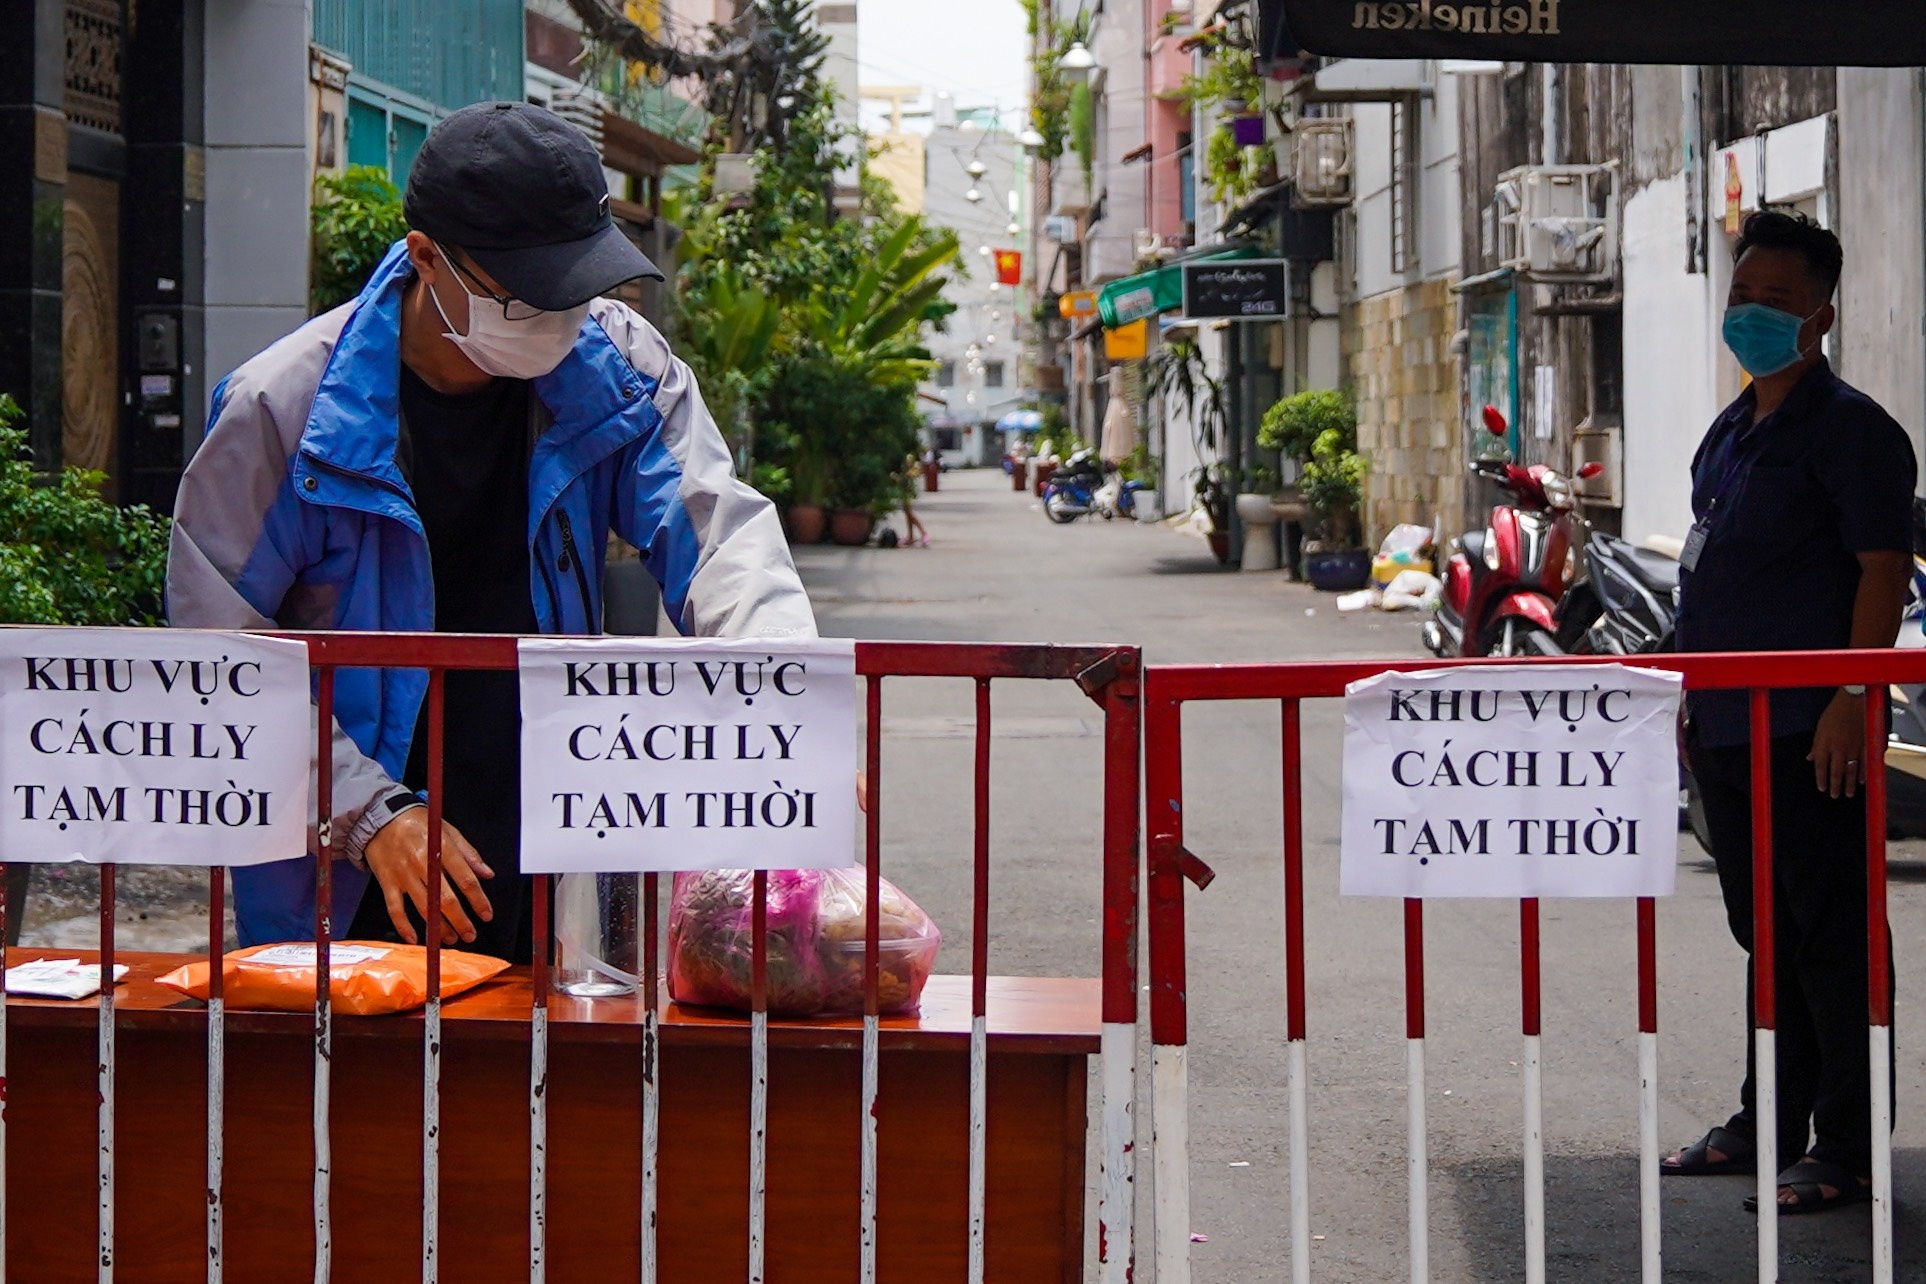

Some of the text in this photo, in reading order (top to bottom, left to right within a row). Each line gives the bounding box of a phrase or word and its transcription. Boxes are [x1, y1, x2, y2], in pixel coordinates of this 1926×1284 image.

[22, 654, 262, 706] KHU VỰC
[563, 655, 806, 706] KHU VỰC
[30, 708, 257, 760] CÁCH LY
[1387, 683, 1632, 733] KHU VỰC
[568, 713, 802, 761] CÁCH LY
[1391, 739, 1625, 788] CÁCH LY
[13, 779, 272, 831] TẠM THỜI
[552, 780, 818, 839] TẠM THỜI
[1373, 807, 1640, 866] TẠM THỜI
